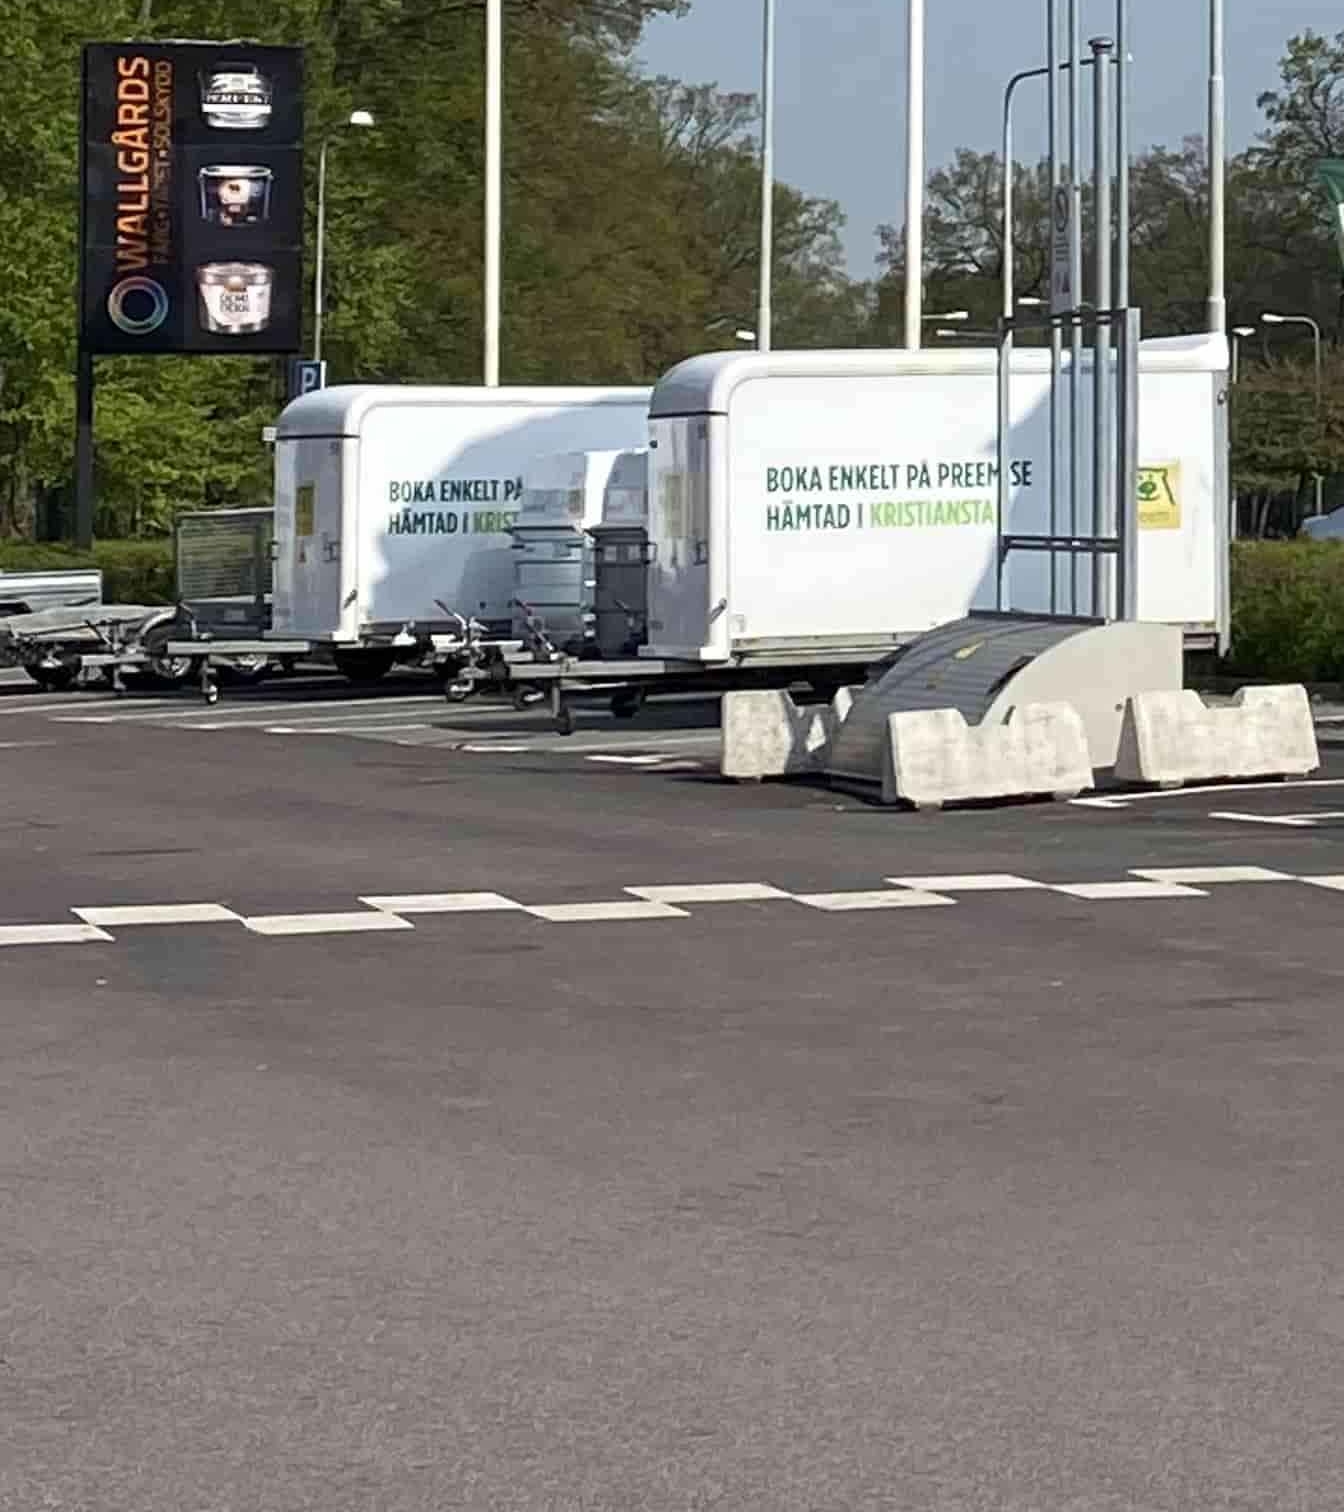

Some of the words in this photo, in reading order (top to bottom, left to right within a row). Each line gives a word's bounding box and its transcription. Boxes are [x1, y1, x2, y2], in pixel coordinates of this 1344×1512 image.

[153, 60, 172, 149] SOLSKYDD
[112, 56, 149, 272] WALLGÅRDS
[302, 367, 317, 395] P
[389, 479, 435, 502] BOKA
[440, 479, 500, 501] ENKELT
[766, 465, 822, 492] BOKA
[829, 463, 900, 491] ENKELT
[907, 460, 931, 489] PÅ
[388, 507, 458, 534] HÄMTAD
[766, 499, 850, 531] HÄMTAD
[870, 498, 995, 528] KRISTIANSTA
